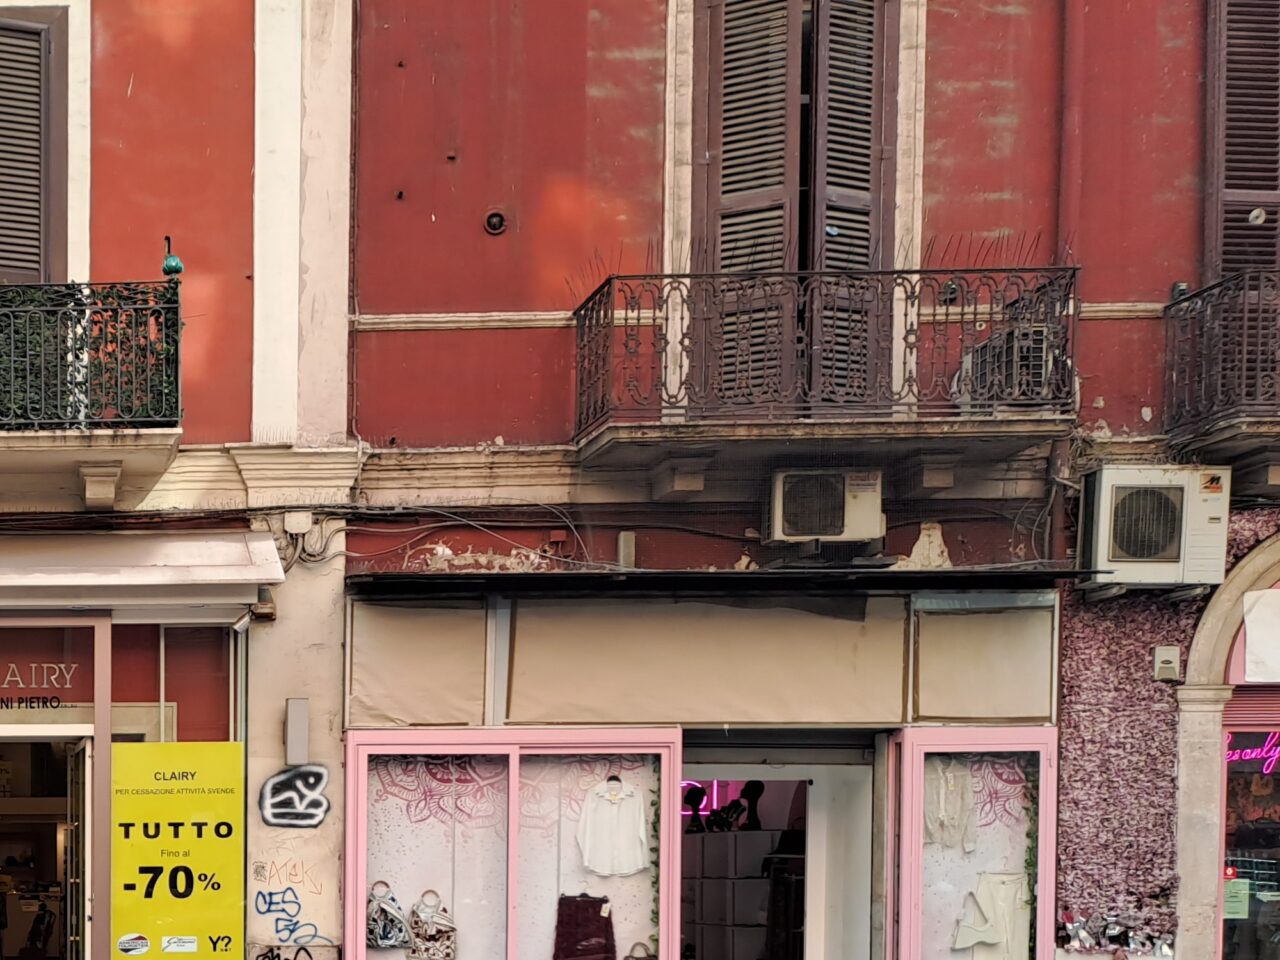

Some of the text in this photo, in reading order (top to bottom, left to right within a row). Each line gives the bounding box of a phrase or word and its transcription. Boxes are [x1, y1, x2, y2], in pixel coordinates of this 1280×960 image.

[18, 696, 60, 709] PIETRO
[153, 771, 197, 781] CLAIRY
[118, 821, 233, 839] TUTTO
[160, 849, 190, 858] Fino al
[123, 865, 221, 899] -70%
